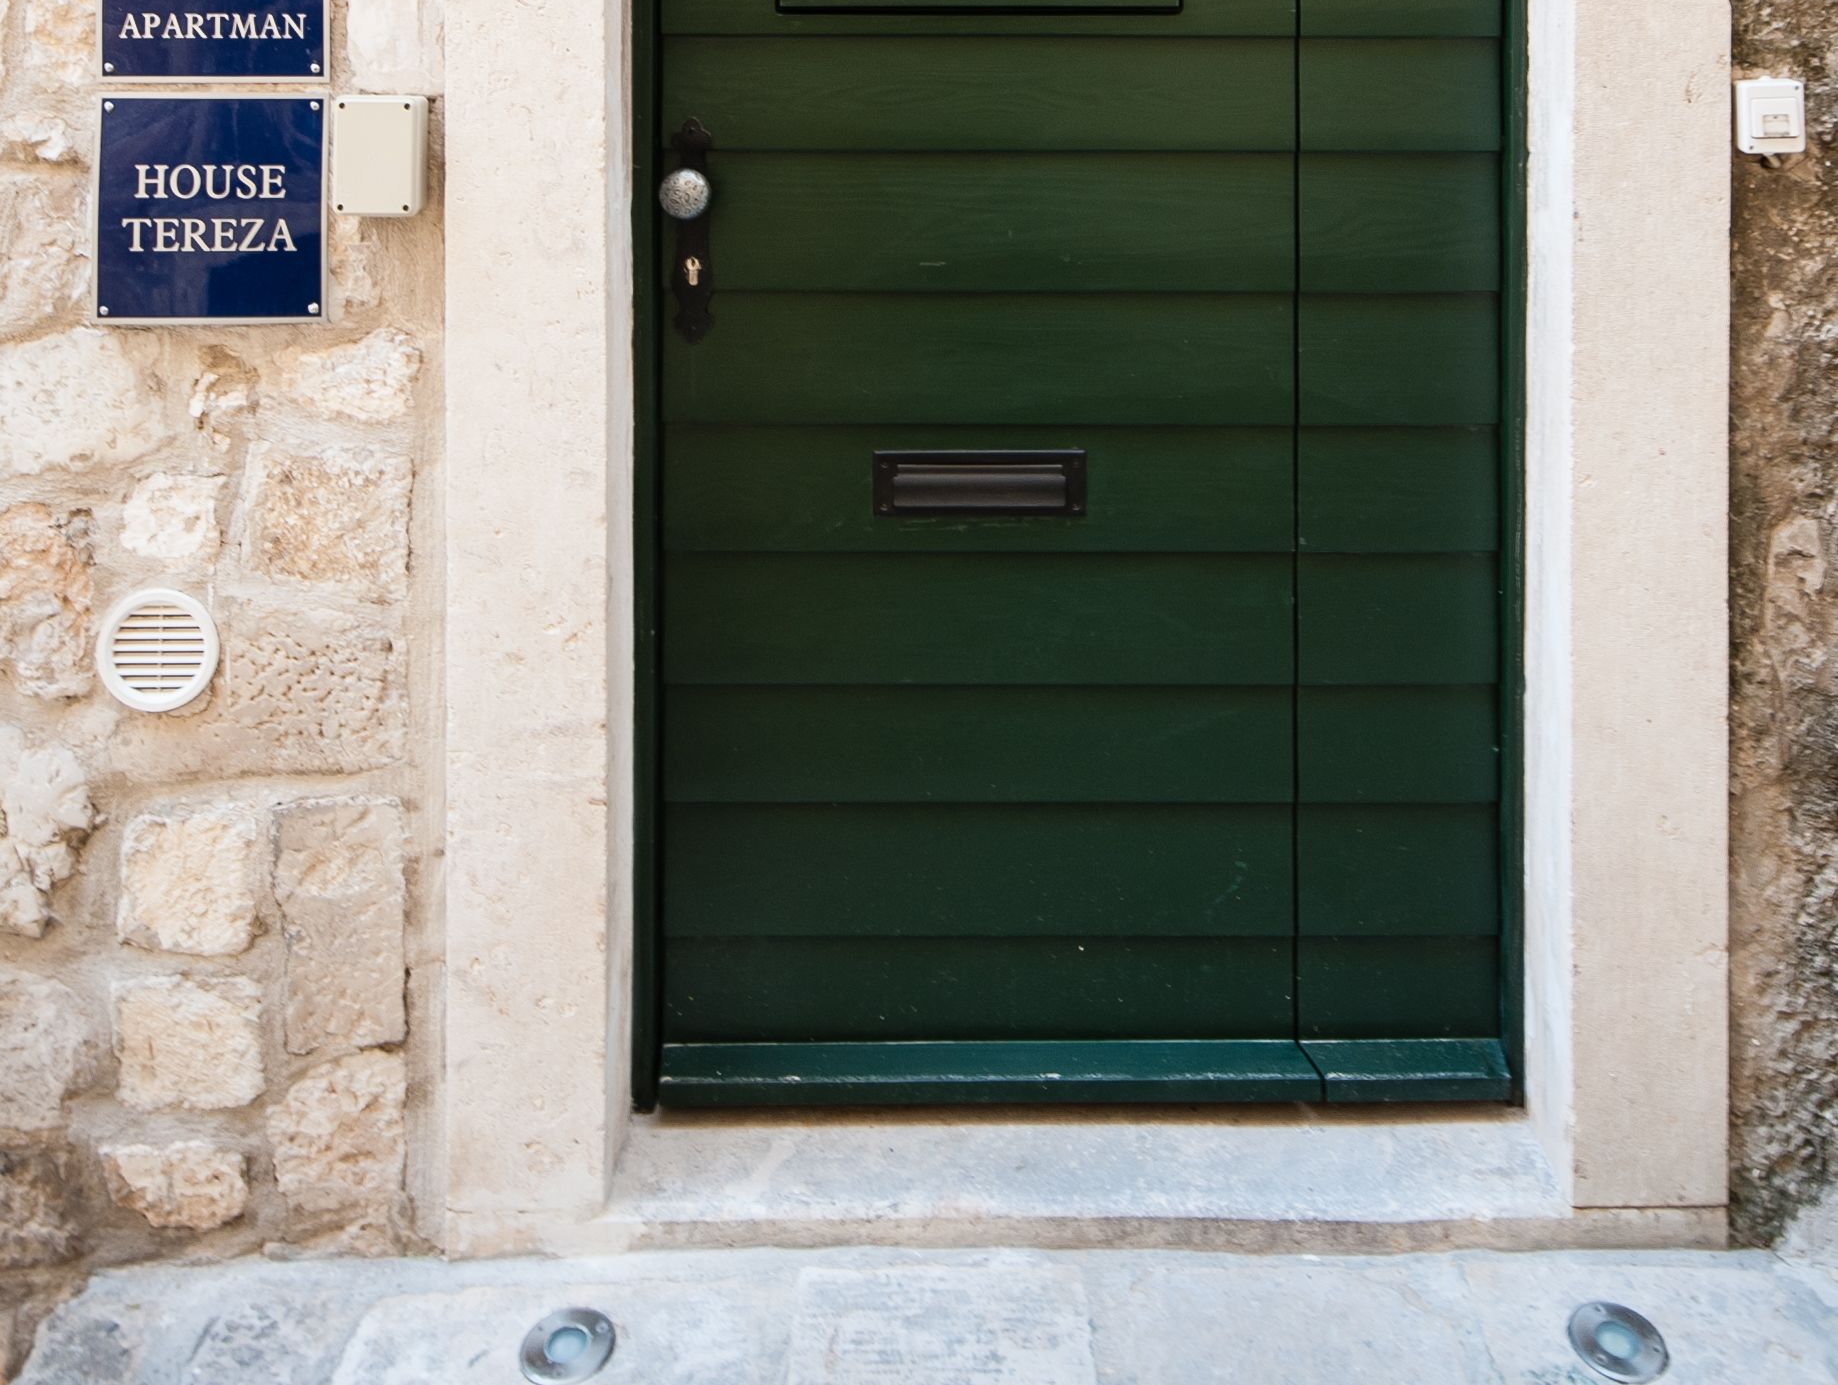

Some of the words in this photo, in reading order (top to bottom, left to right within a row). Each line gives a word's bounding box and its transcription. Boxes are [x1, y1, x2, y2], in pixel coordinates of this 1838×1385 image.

[119, 13, 307, 40] APARTMAN
[134, 164, 287, 200] HOUSE
[121, 218, 298, 253] TEREZA
